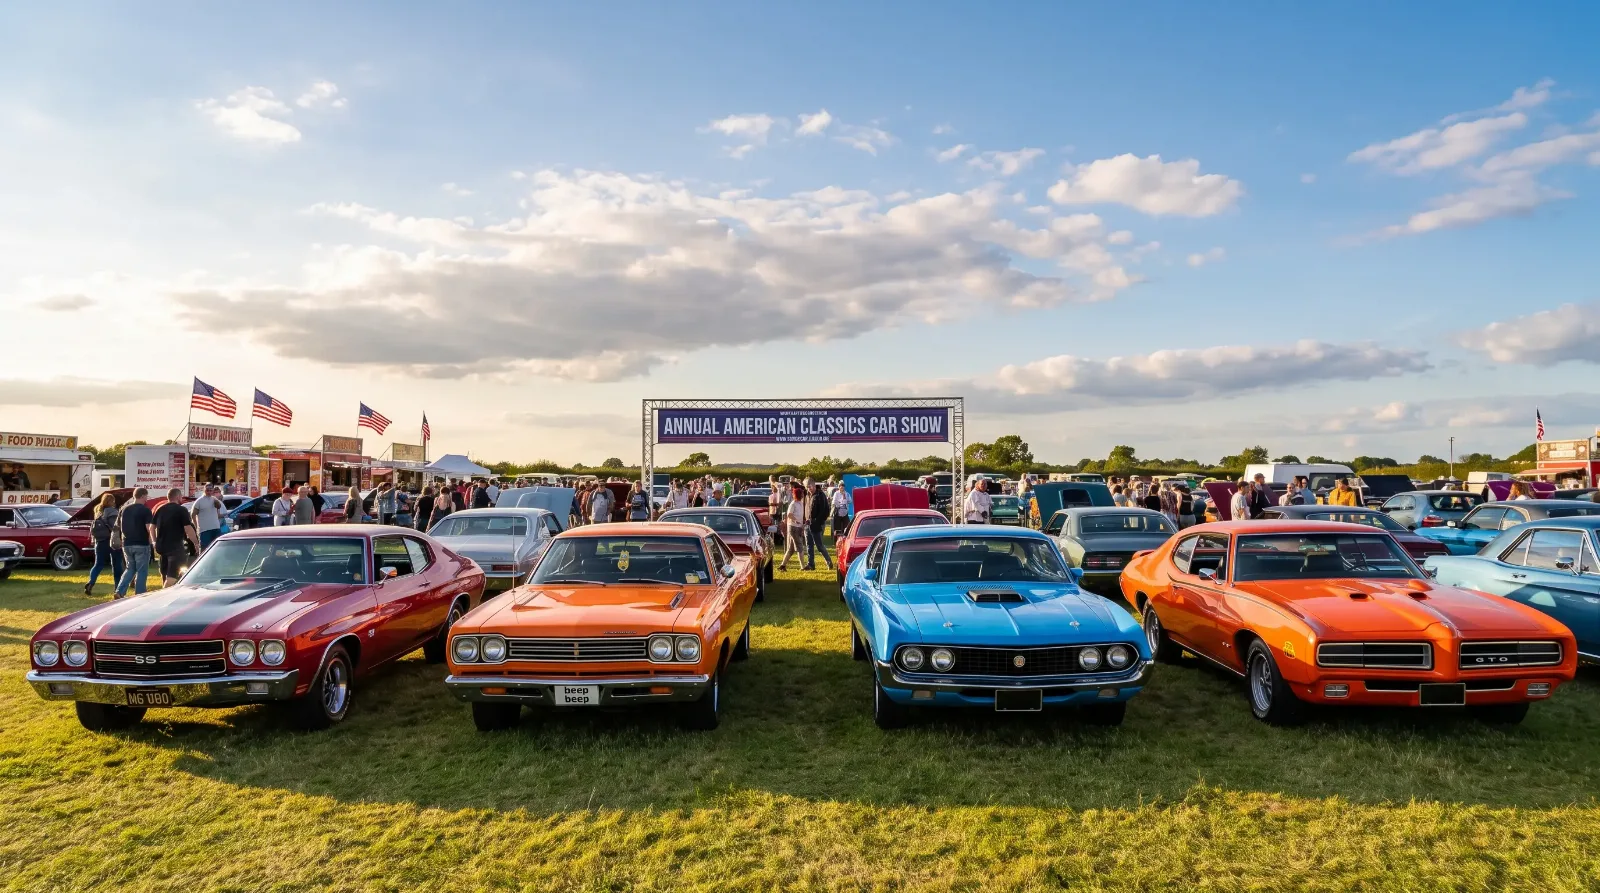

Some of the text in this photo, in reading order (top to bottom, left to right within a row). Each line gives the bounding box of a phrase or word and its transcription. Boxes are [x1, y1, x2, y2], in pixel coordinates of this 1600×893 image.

[663, 415, 942, 435] ANNUAL AMERICAN CLASSICS CAR SHOW
[7, 435, 34, 447] FOOD
[134, 655, 157, 664] SS
[564, 686, 589, 696] beep
[564, 695, 590, 704] beep
